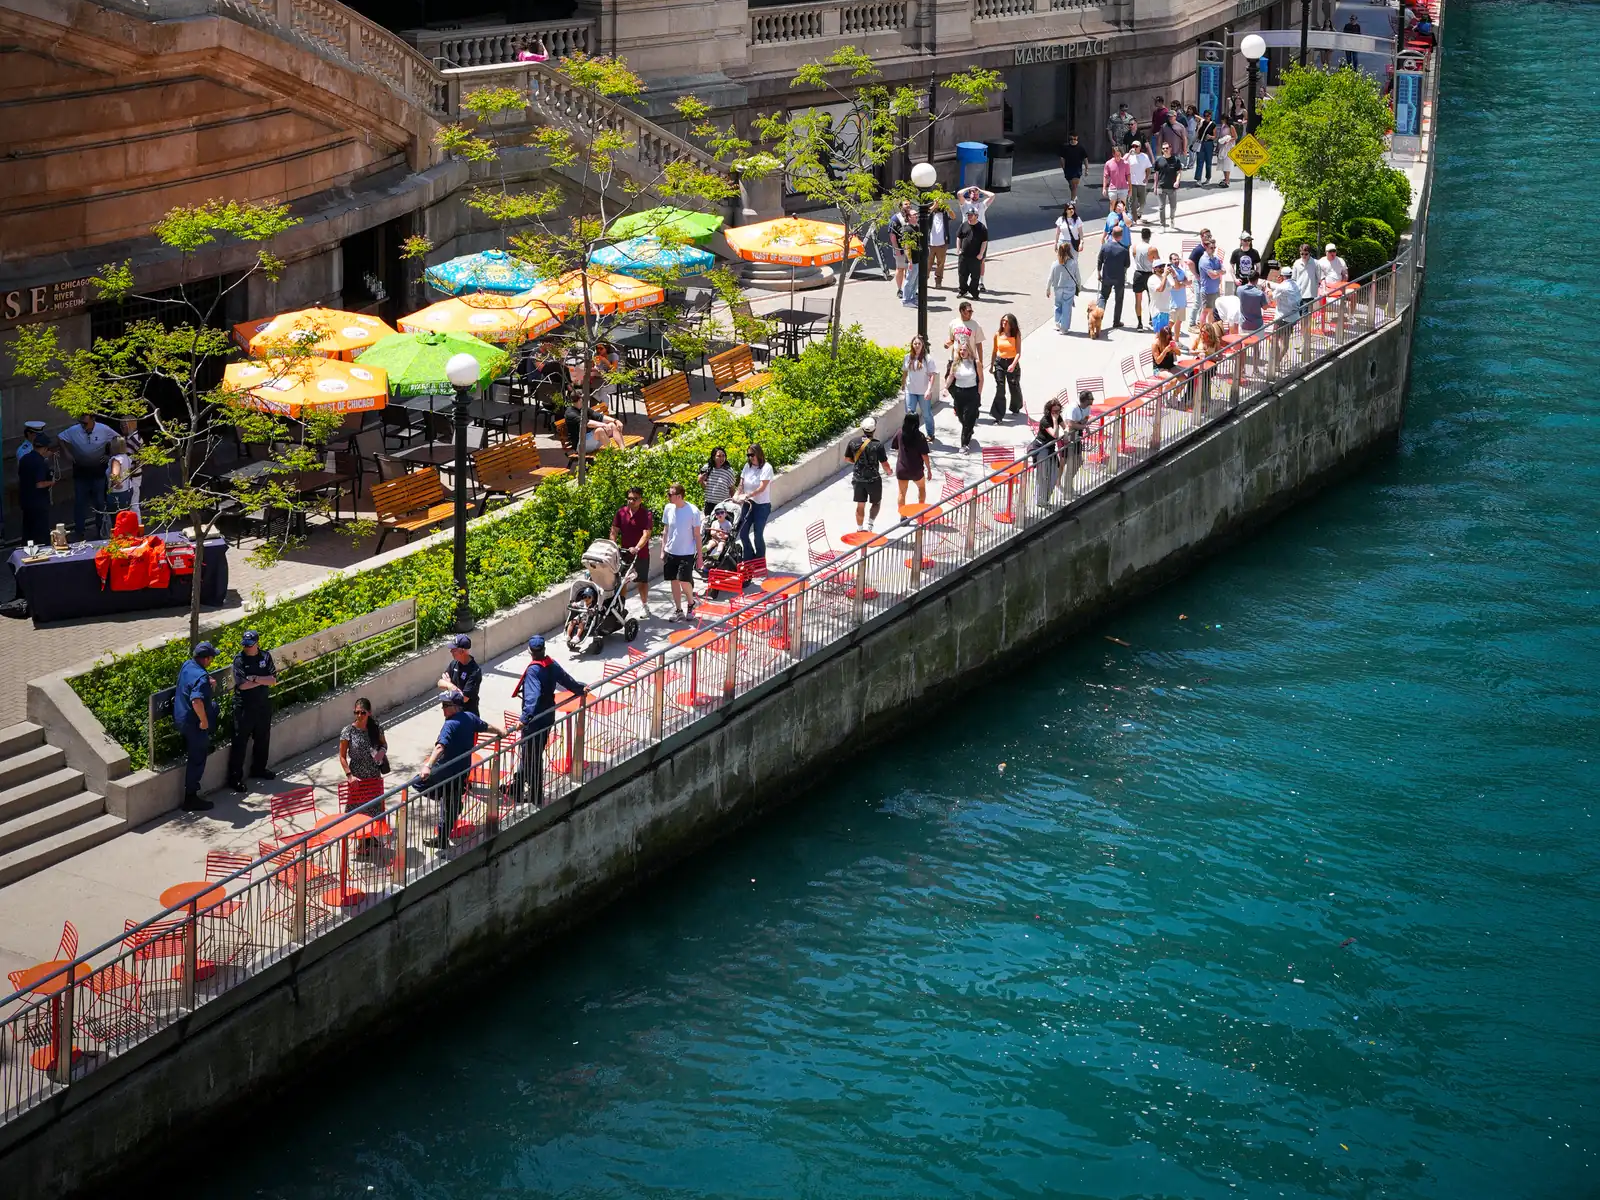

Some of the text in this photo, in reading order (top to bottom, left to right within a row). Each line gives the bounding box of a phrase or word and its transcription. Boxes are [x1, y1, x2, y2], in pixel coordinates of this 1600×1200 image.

[1014, 39, 1109, 66] MARKETPLACE
[60, 278, 90, 290] CHICAGO
[54, 291, 75, 300] RIVER
[346, 397, 376, 409] CHICAGO
